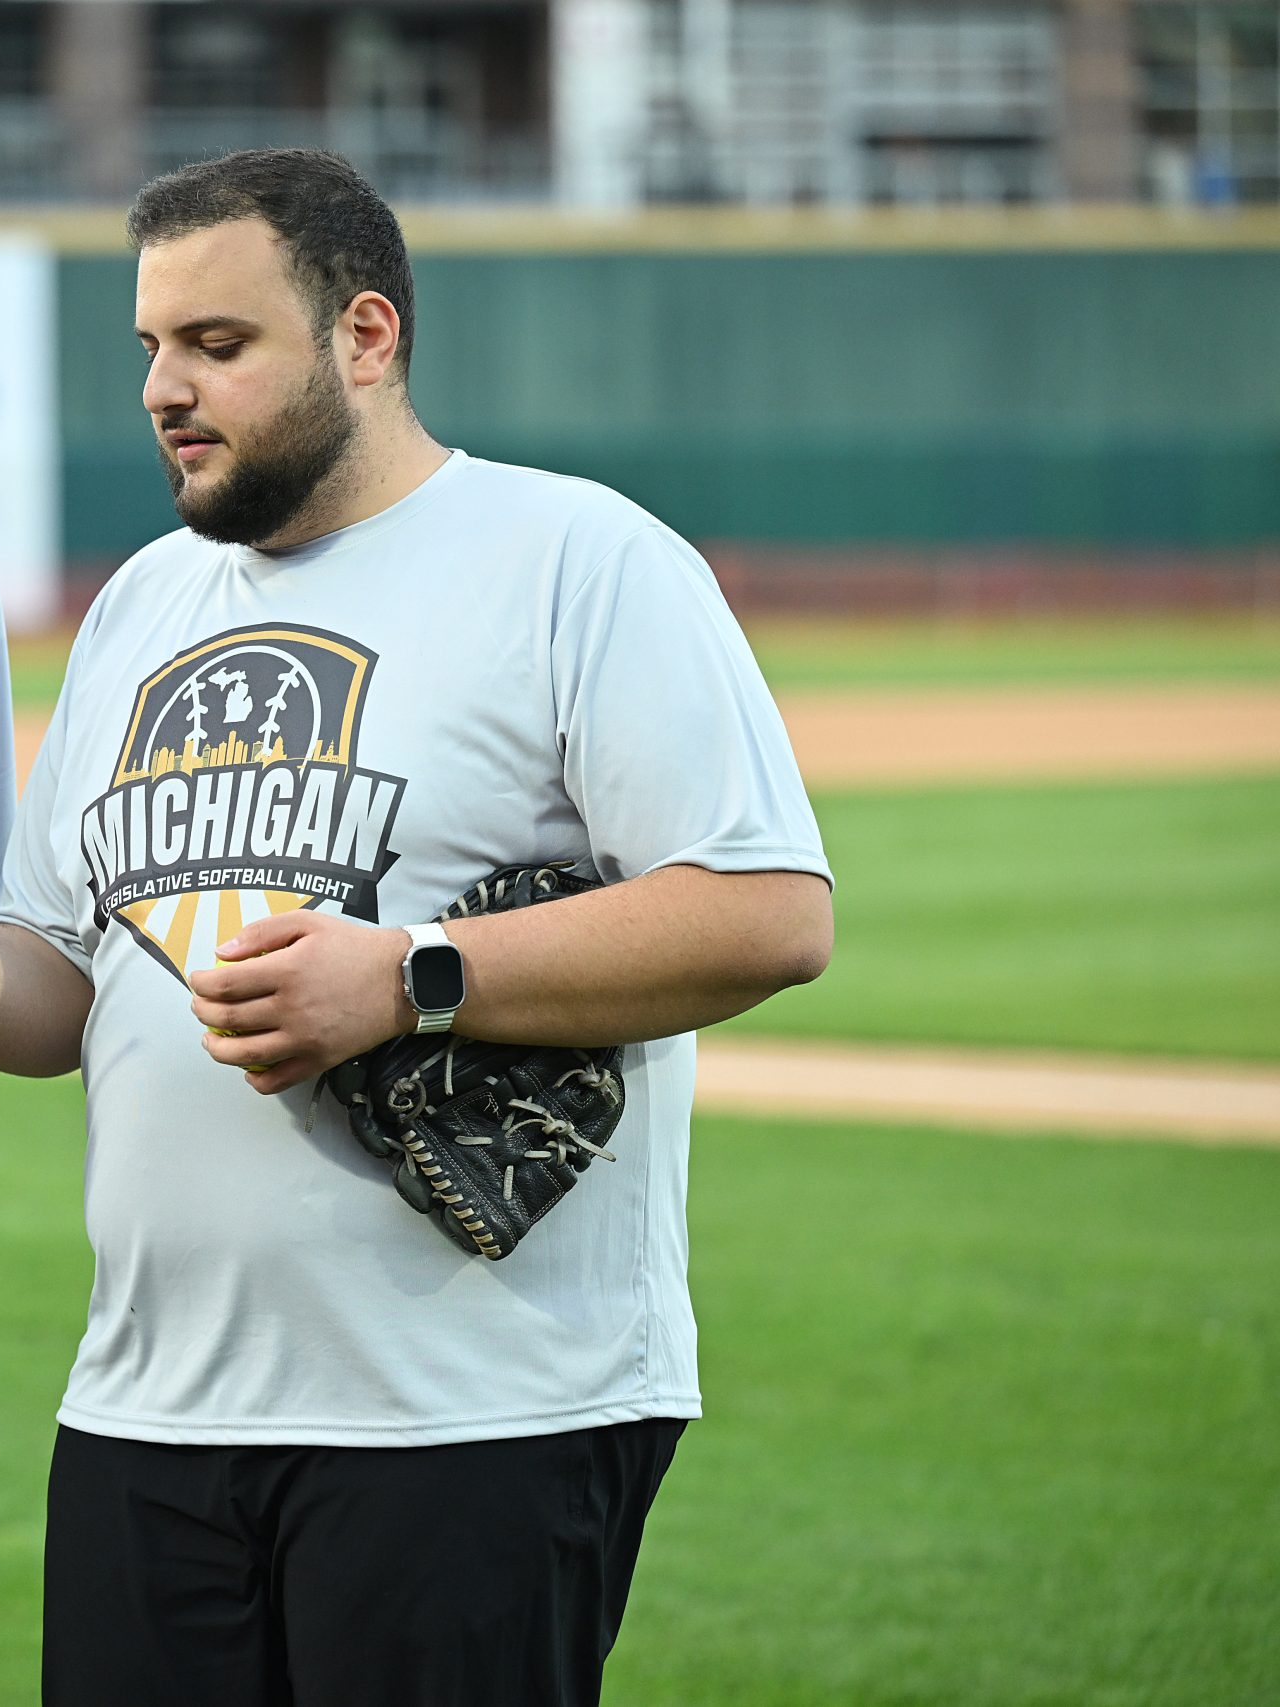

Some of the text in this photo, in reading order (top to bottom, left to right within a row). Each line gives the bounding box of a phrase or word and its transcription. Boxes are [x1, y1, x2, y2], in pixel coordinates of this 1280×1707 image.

[83, 766, 398, 897] MICHIGAN
[100, 868, 355, 918] LEGISLATIVE SOFTBALL NIGHT
